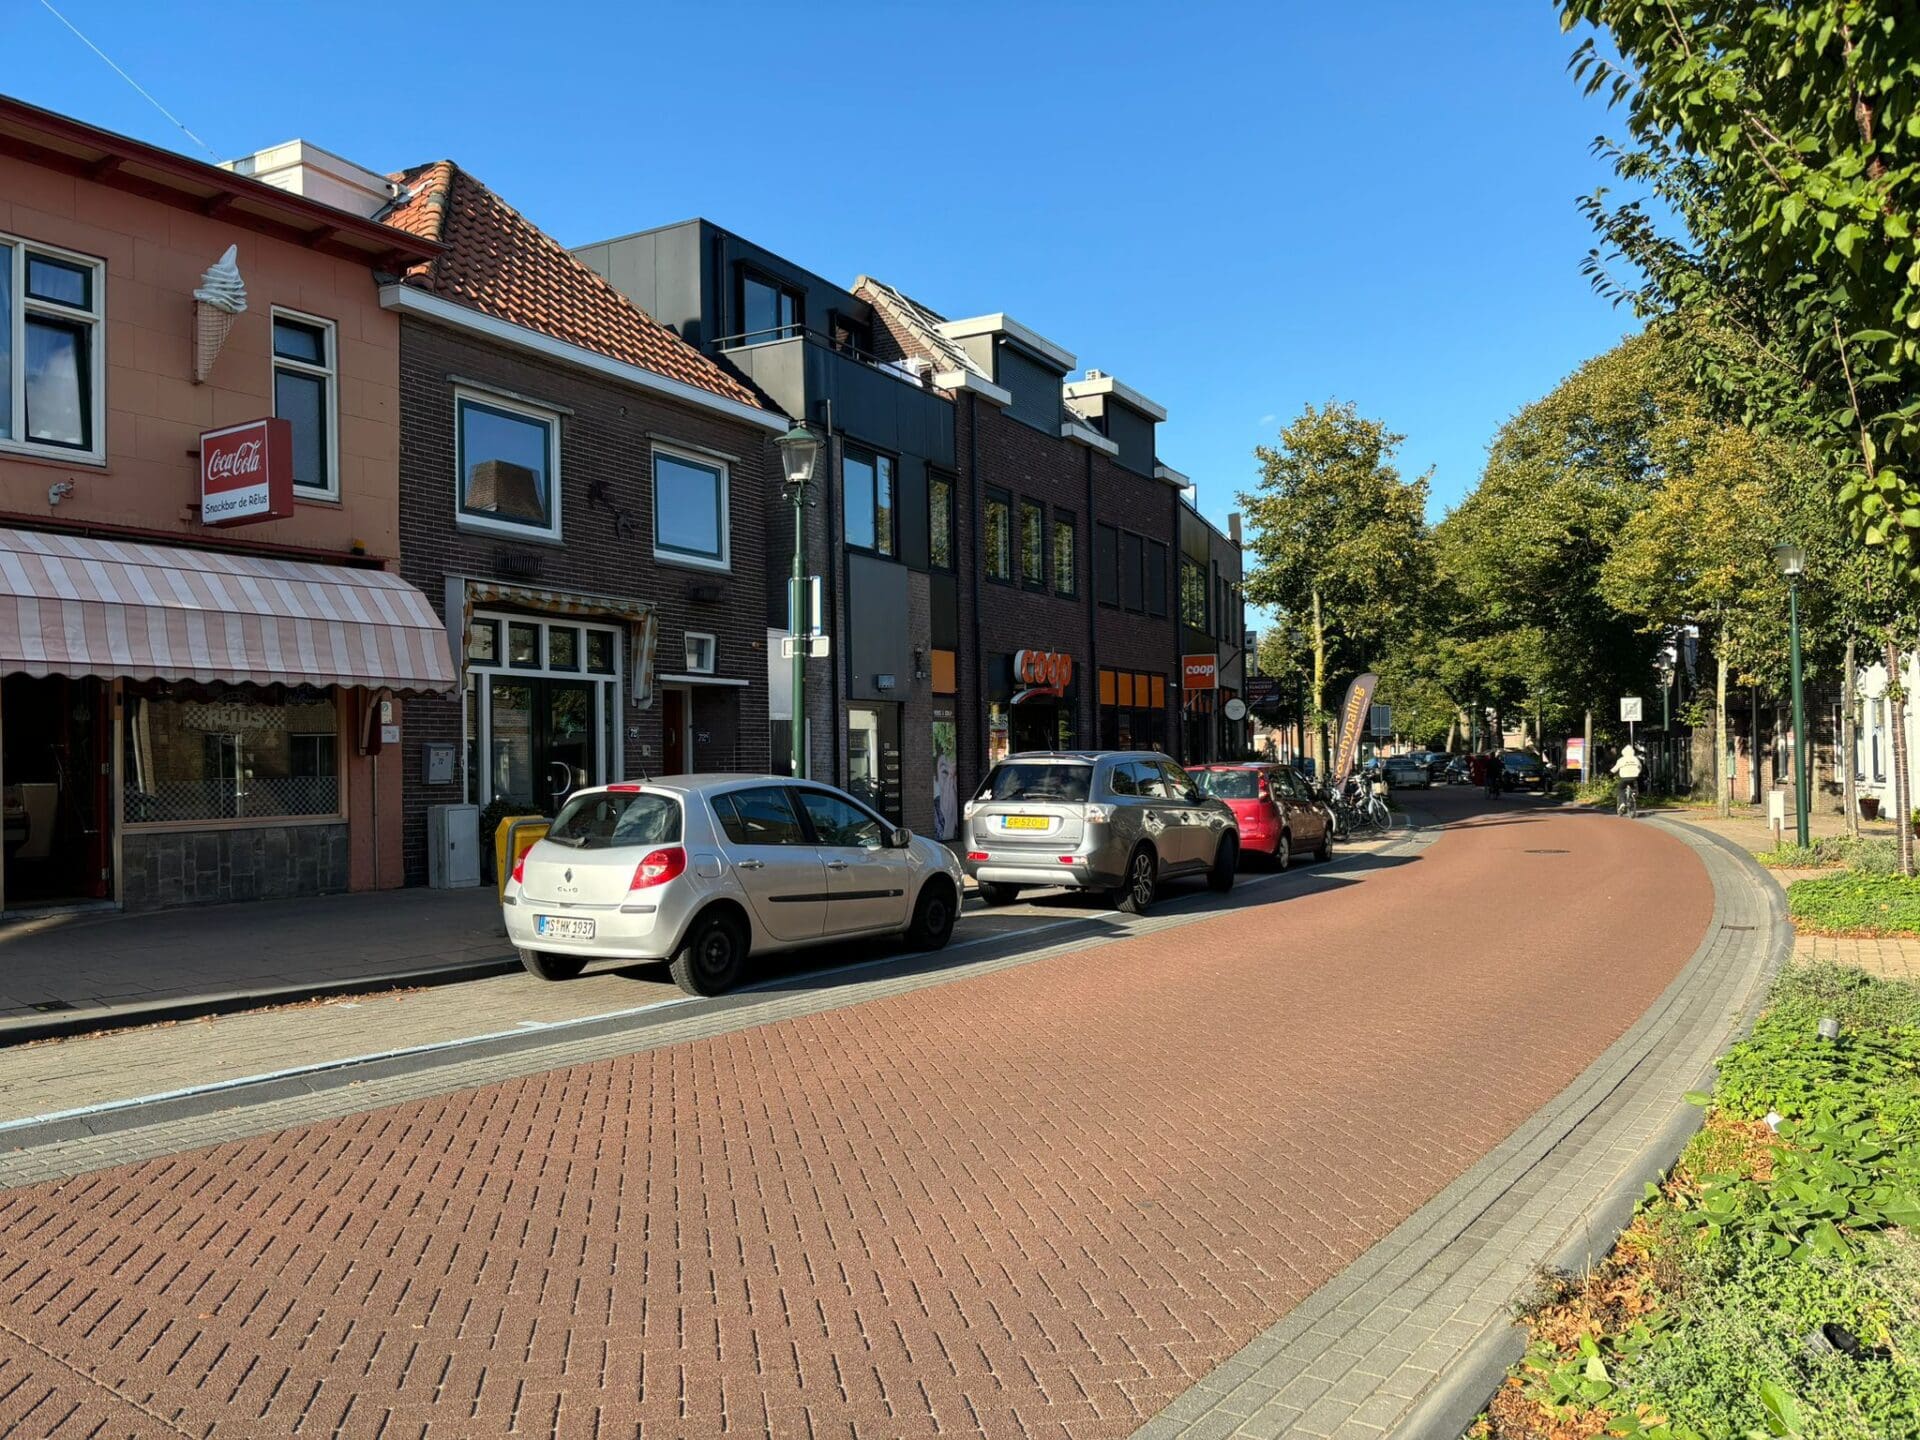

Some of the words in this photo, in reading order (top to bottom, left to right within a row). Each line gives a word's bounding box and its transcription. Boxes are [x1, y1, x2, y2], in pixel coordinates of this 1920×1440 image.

[205, 501, 237, 514] Snackbar
[238, 498, 247, 508] de
[1018, 649, 1072, 698] coop
[1186, 664, 1214, 677] coop
[572, 921, 594, 935] 1937
